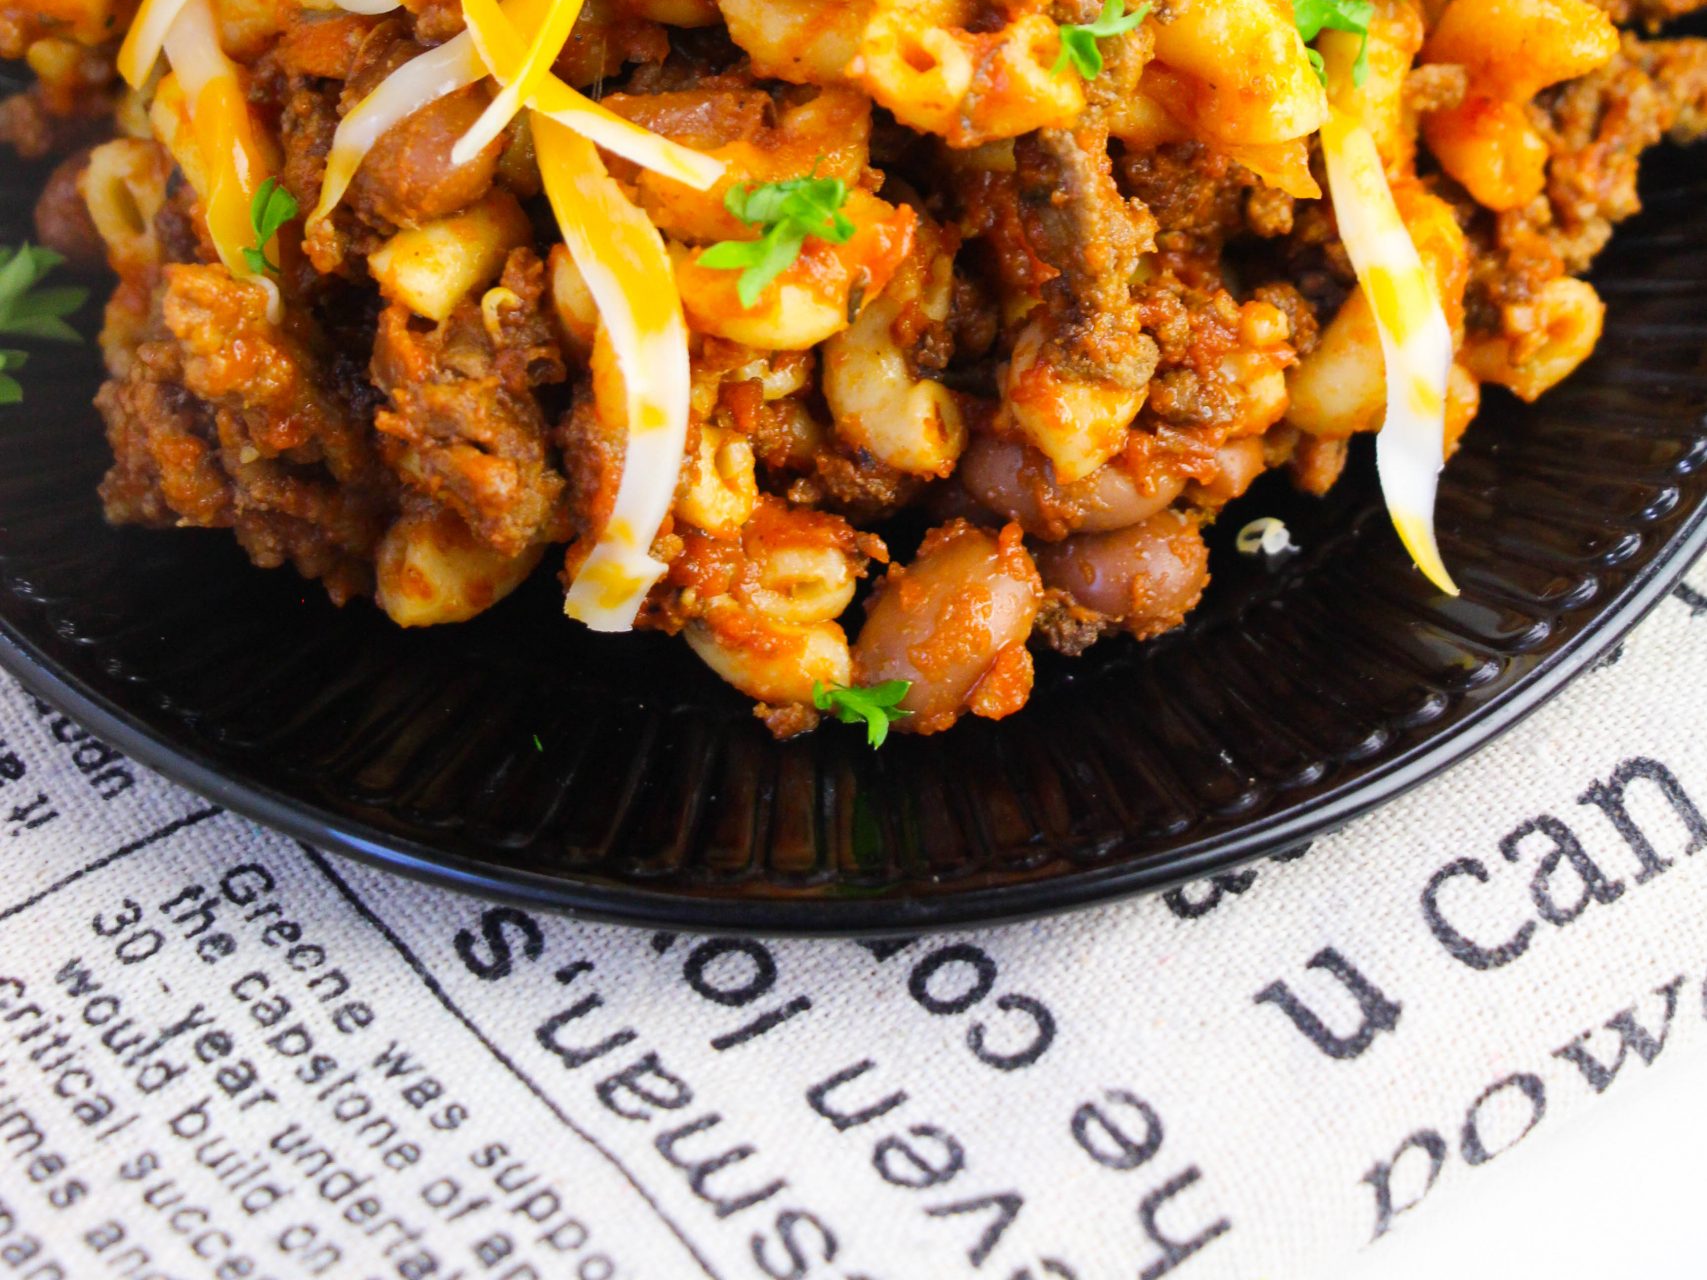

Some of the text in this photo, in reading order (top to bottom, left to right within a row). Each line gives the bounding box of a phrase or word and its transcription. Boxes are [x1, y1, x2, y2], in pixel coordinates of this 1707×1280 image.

[92, 897, 165, 965] 30
[1418, 754, 1707, 972] can
[123, 1002, 278, 1112] year
[159, 884, 238, 965] the
[420, 1177, 492, 1222] of
[650, 931, 813, 1052] lo
[855, 934, 1058, 1073] co
[54, 955, 343, 1276] would build on
[371, 1040, 469, 1130] was
[1357, 973, 1707, 1252] pow
[118, 1150, 268, 1280] succe
[269, 1123, 464, 1280] underta
